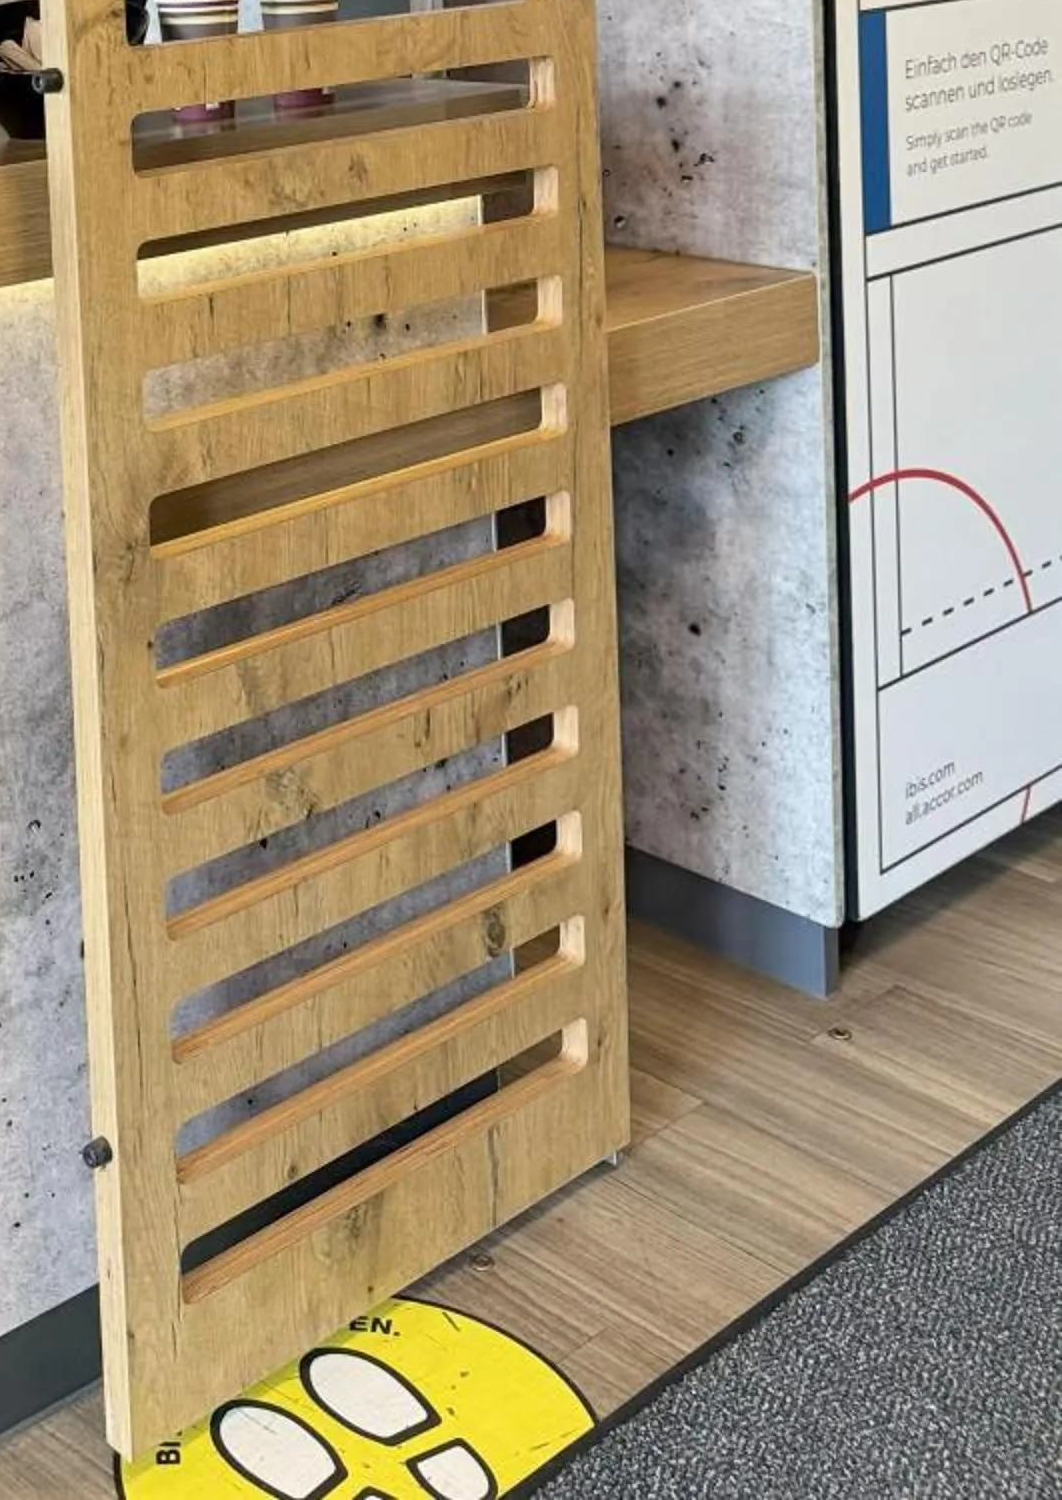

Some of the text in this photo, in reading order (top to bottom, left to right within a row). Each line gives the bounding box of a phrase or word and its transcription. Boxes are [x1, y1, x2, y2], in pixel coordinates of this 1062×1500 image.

[905, 37, 1049, 79] Einfach den QR-Code
[905, 85, 965, 112] scannen
[968, 76, 995, 99] und
[905, 131, 942, 152] Simply
[944, 126, 969, 143] scan
[990, 115, 1007, 133] QR
[1008, 112, 1033, 128] code
[906, 158, 928, 177] and
[930, 155, 949, 175] get
[905, 761, 955, 800] ibis.com
[905, 771, 984, 826] all.accor.com
